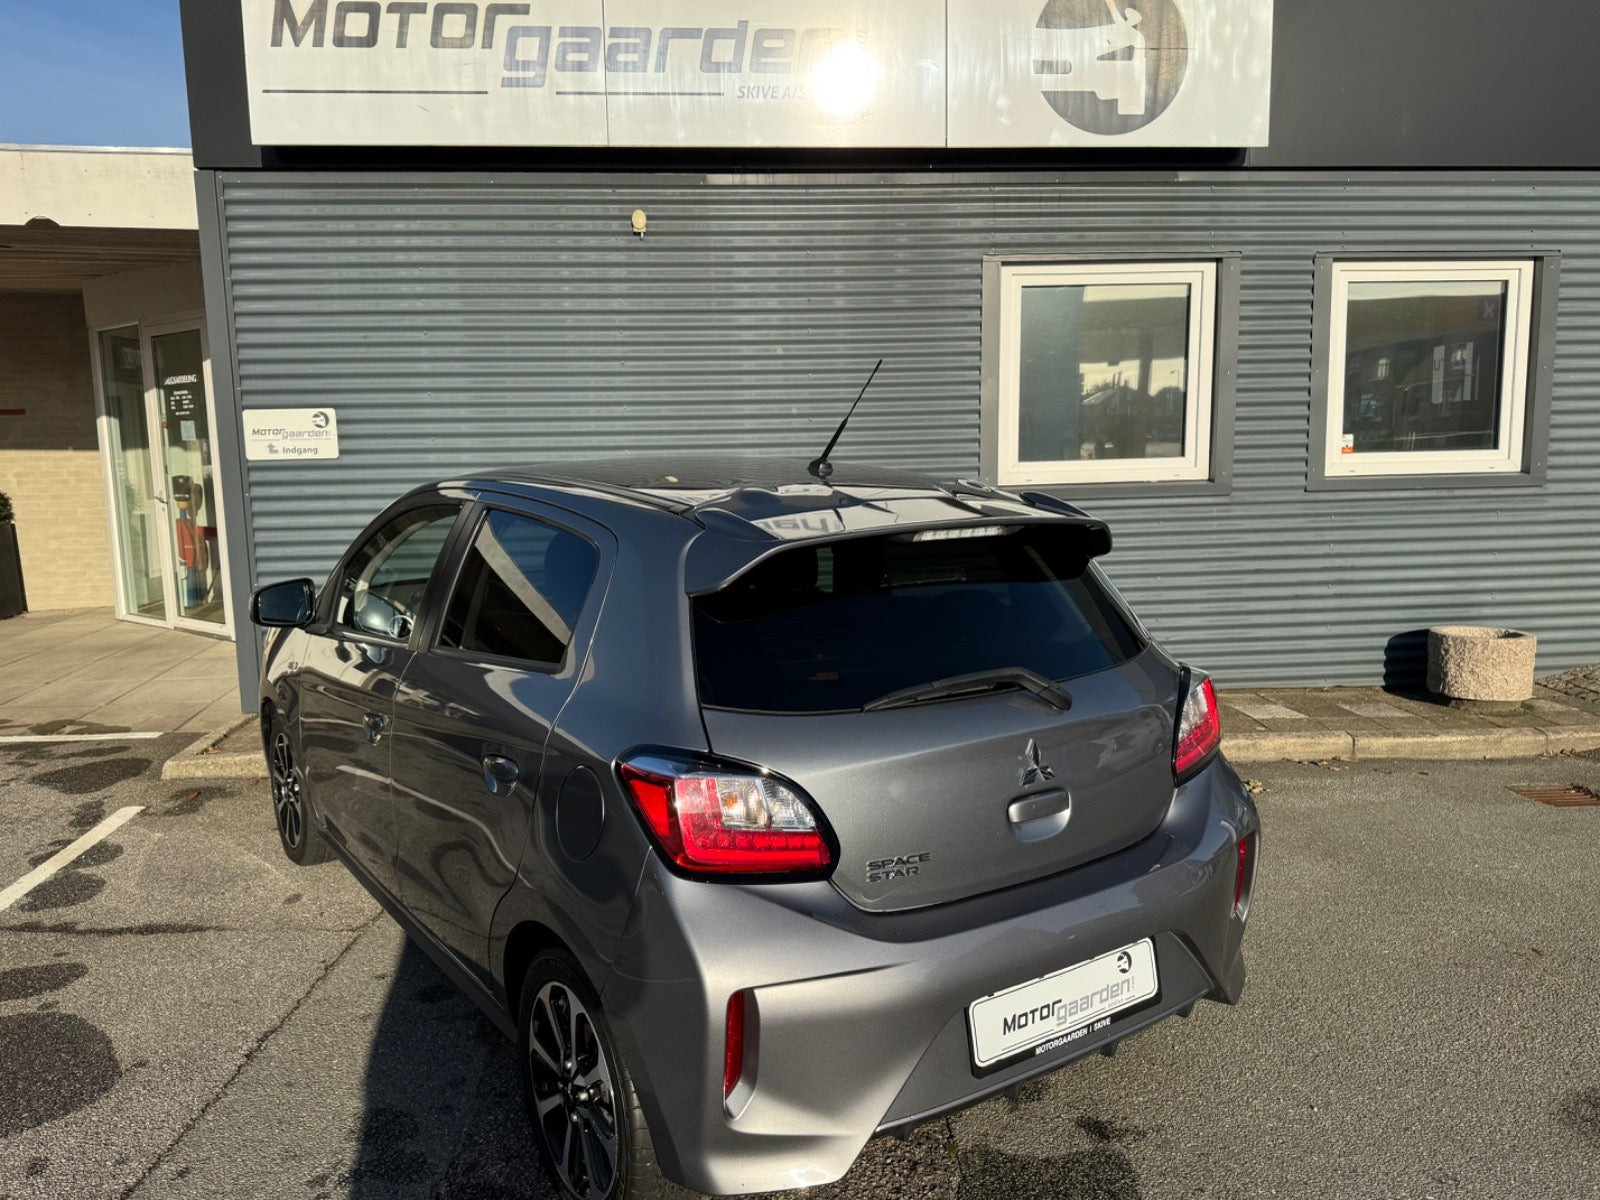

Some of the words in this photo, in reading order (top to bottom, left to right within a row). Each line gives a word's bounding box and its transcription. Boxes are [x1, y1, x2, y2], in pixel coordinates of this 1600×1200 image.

[737, 85, 779, 99] SKIVE
[282, 446, 318, 455] Indgang
[866, 852, 931, 871] SPACE
[866, 866, 920, 882] STAR
[1035, 1026, 1088, 1055] MOTORGAARDEN
[1093, 1016, 1112, 1031] SKIVE
